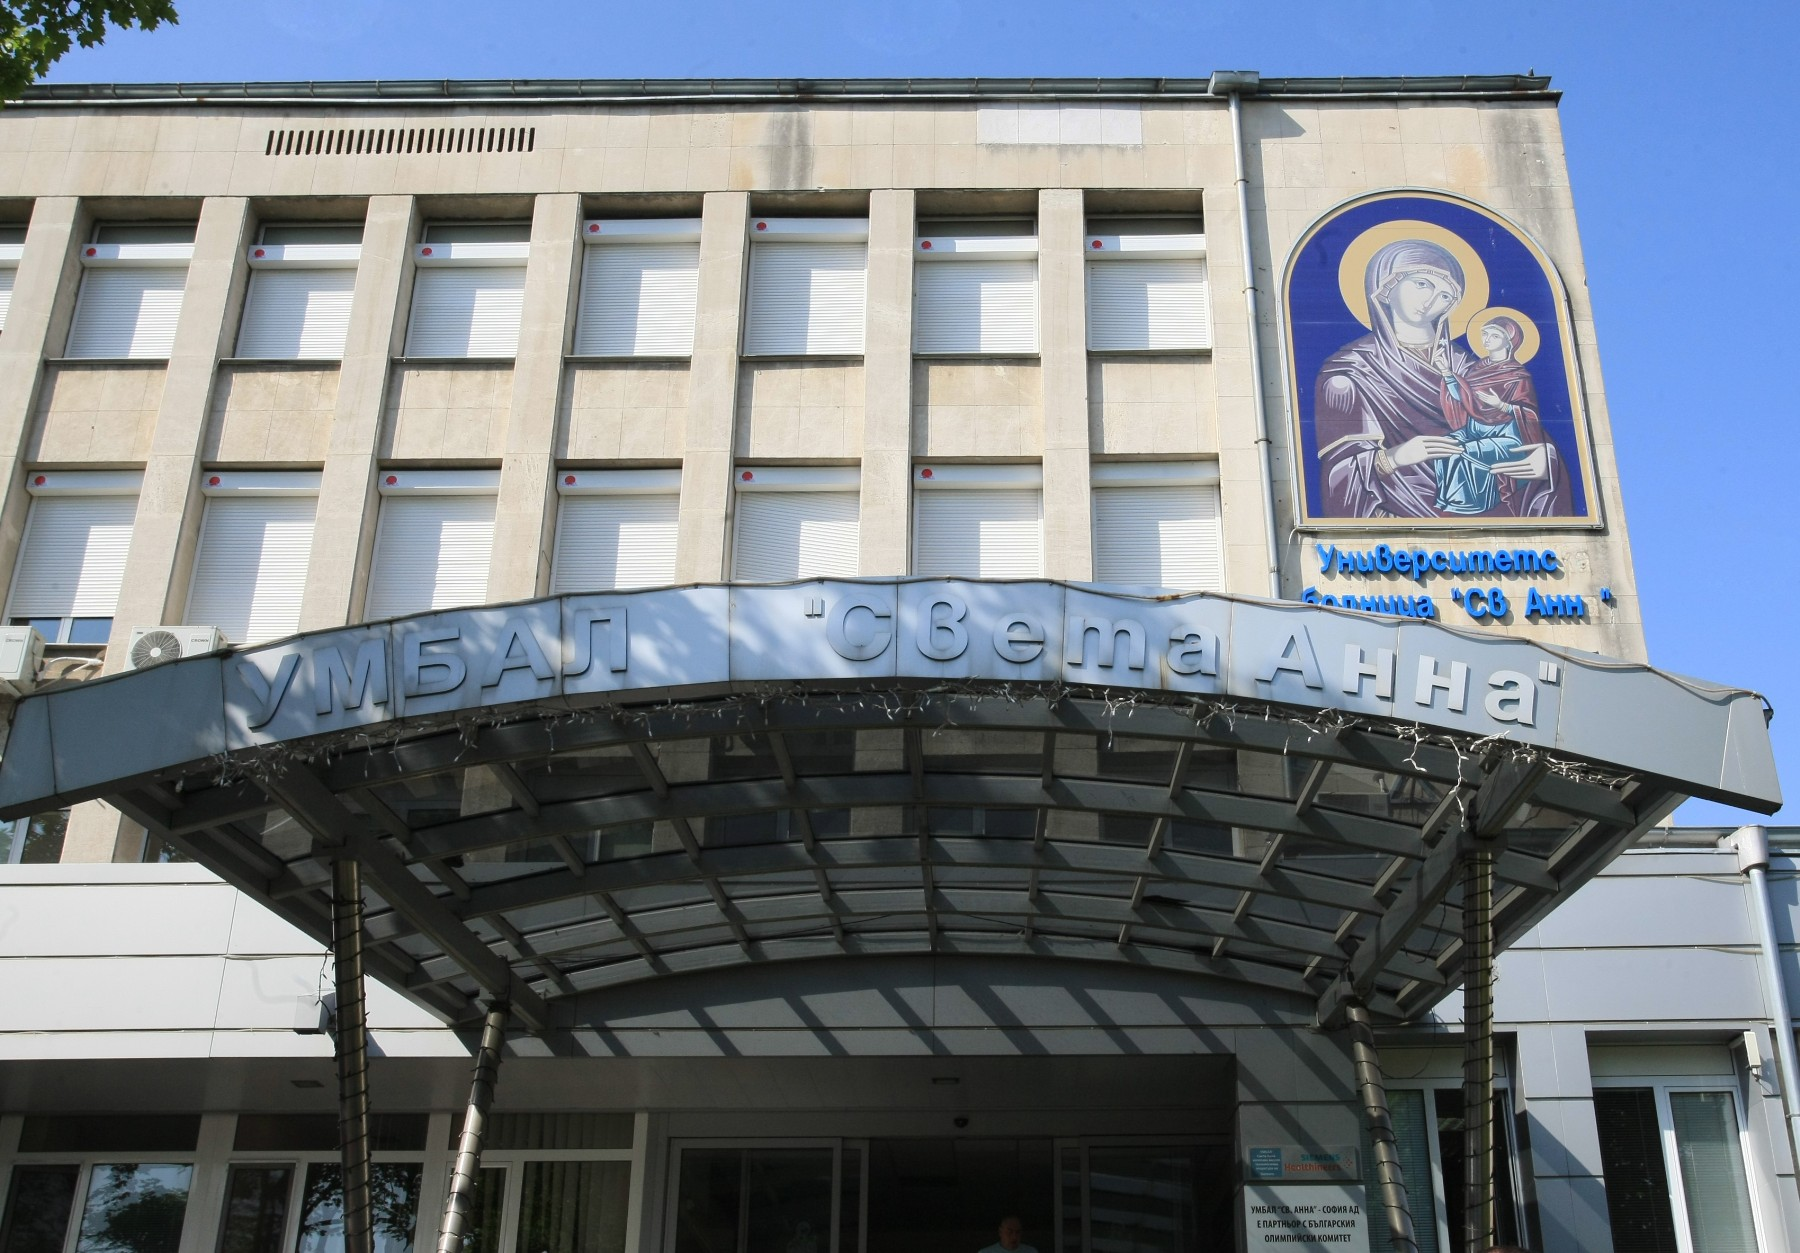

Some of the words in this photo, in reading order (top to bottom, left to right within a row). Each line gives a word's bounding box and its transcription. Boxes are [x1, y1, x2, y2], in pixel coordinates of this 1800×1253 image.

[1315, 543, 1559, 581] Университетс
[1451, 587, 1507, 619] "Св
[236, 607, 629, 732] УМБАЛ
[803, 592, 1221, 676] "Света
[1255, 623, 1561, 728] Анна"
[1300, 1153, 1340, 1161] SIEMENS
[1251, 1205, 1276, 1214] УМБАЛ
[1322, 1205, 1348, 1214] СОФИЯ
[1349, 1205, 1360, 1215] АД
[1263, 1220, 1301, 1228] ПАРТНЬОР
[1308, 1220, 1356, 1228] БЪЛГАРСКИЯ
[1264, 1233, 1316, 1242] ОЛИМПИЙСКИ
[1318, 1234, 1351, 1242] КОМИТЕТ
